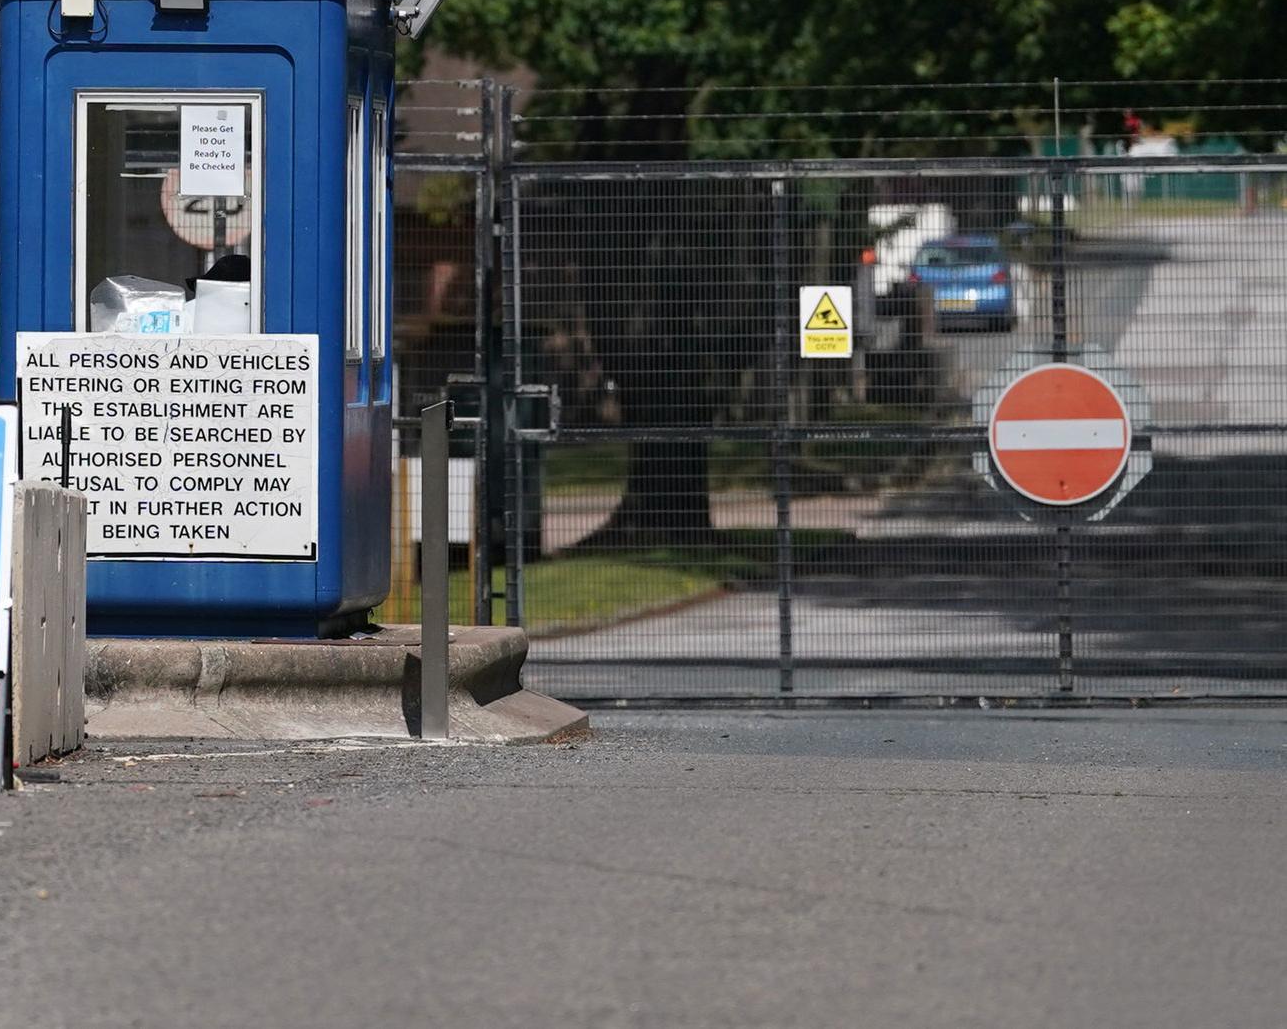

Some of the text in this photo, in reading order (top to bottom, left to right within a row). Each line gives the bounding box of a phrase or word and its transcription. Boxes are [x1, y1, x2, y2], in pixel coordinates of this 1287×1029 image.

[192, 124, 234, 133] Please Get
[199, 137, 226, 145] ID Out
[194, 150, 231, 159] Ready To
[189, 162, 235, 171] Be Checked
[26, 353, 310, 371] ALL PERSONS AND VEHICLES
[29, 377, 306, 395] ENTERING OR EXITING FROM
[41, 401, 294, 420] THS ESTABLISHMENT ARE
[28, 425, 306, 443] LIAE TO BE SEARCHED BY
[173, 452, 287, 468] PERSONNEL
[41, 476, 291, 492] FUSAL TO COMPLY MAY
[109, 500, 127, 515] IN
[137, 500, 223, 516] FURTHER
[233, 501, 302, 517] ACTION
[102, 524, 230, 540] BEING TAKEN
